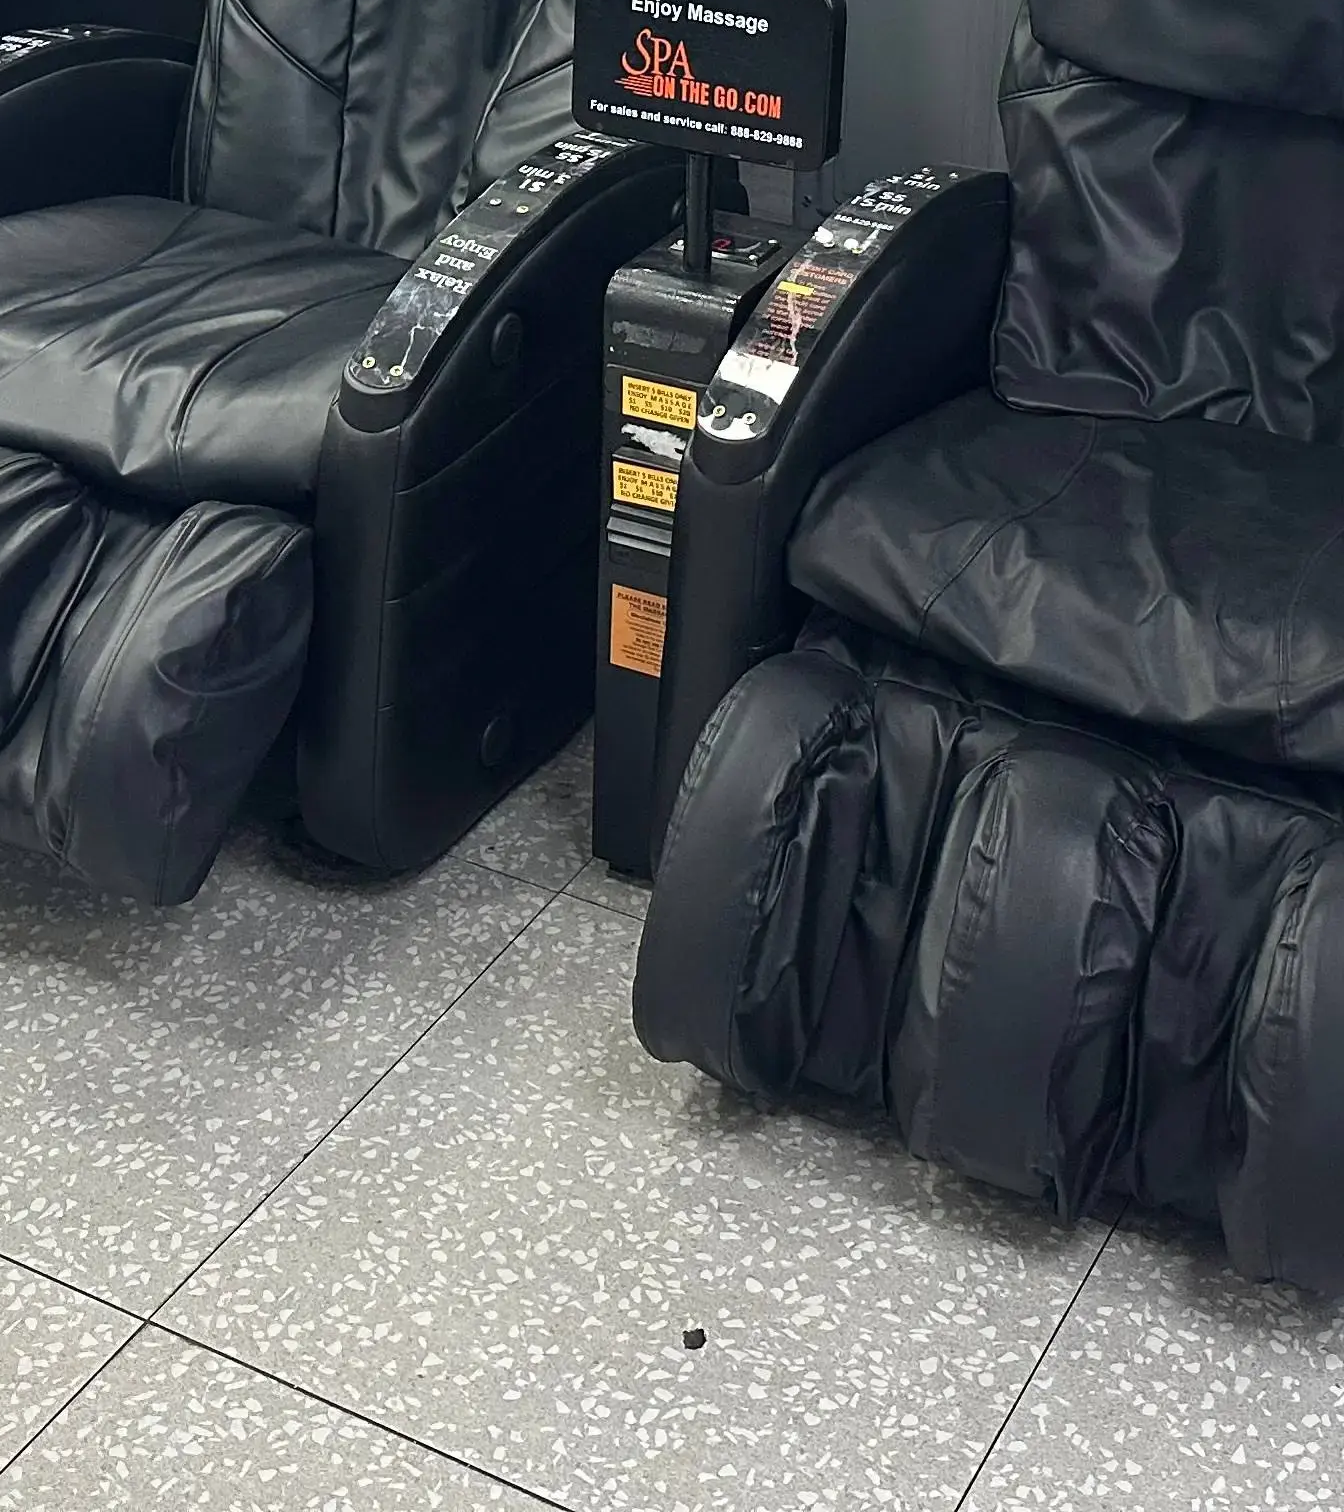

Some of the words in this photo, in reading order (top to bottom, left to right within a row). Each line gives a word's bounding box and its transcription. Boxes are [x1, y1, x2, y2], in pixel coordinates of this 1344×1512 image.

[687, 2, 769, 35] Massage
[621, 28, 695, 80] SPA
[652, 76, 675, 100] ON
[680, 78, 709, 106] THE
[590, 99, 609, 114] For
[610, 104, 638, 118] sales
[640, 108, 661, 123] and
[663, 113, 703, 131] service
[705, 121, 728, 136] call:
[518, 164, 555, 179] min
[518, 178, 546, 192] $1
[903, 179, 941, 190] min
[879, 191, 908, 202] $5
[439, 234, 499, 261] Enjoy
[434, 253, 476, 271] and
[414, 266, 473, 295] Relax
